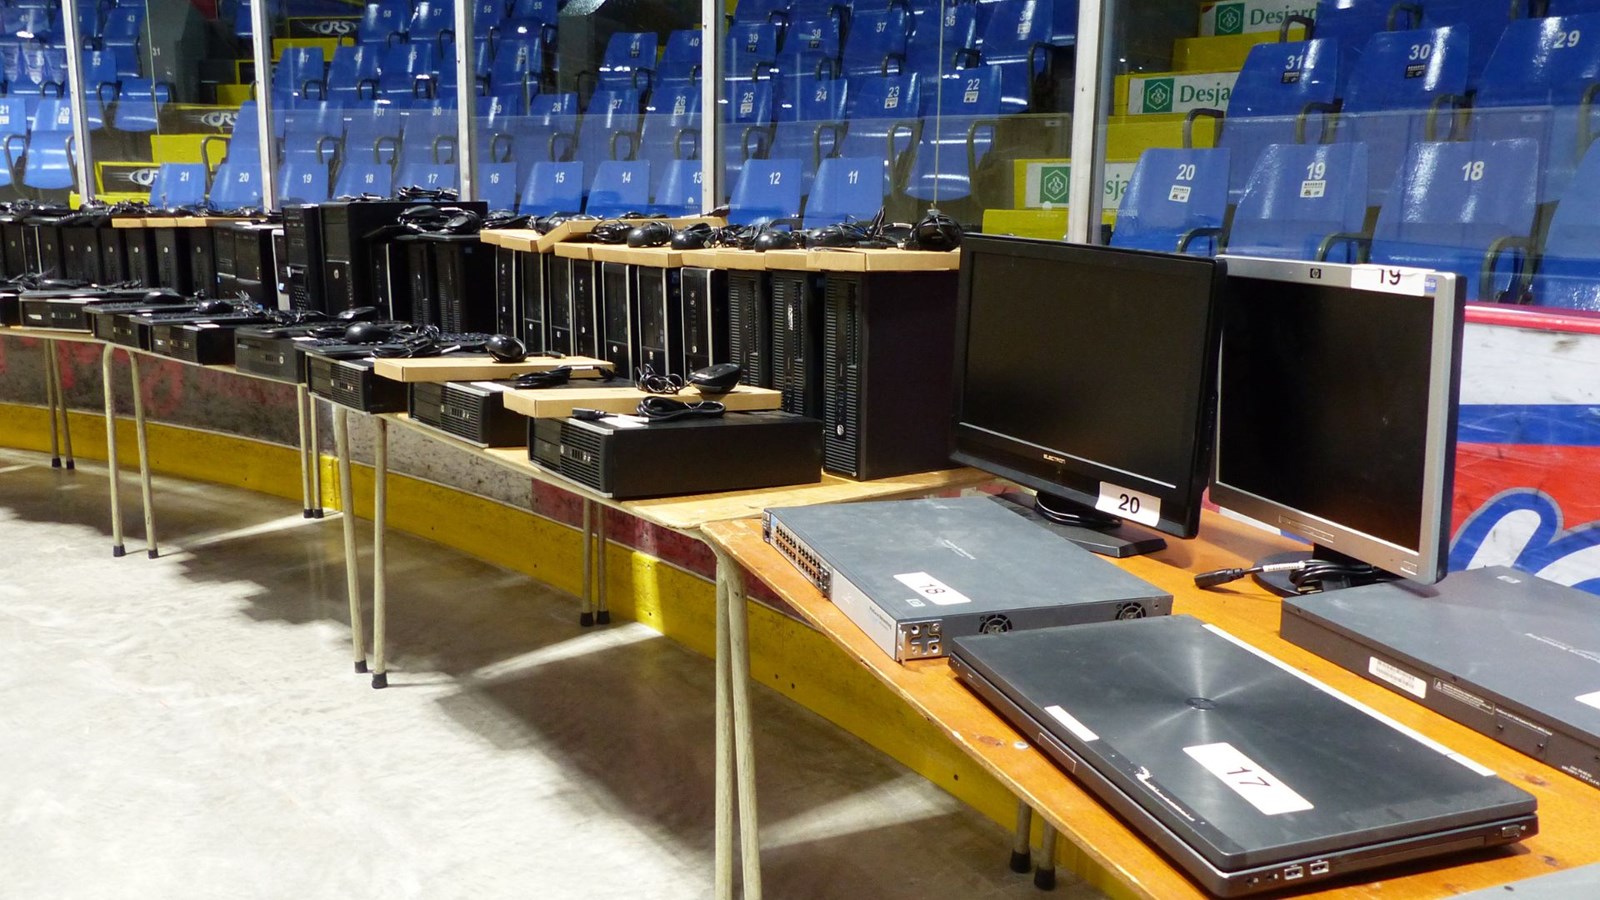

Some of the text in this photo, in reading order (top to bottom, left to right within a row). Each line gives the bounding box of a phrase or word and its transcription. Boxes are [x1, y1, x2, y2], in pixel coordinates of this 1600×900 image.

[876, 22, 887, 33] 37
[631, 41, 640, 50] 41
[689, 38, 700, 47] 40
[1553, 30, 1580, 49] 29
[1408, 44, 1431, 60] 30
[1286, 54, 1303, 70] 31
[966, 78, 980, 91] 22
[742, 92, 754, 103] 25
[815, 90, 827, 102] 24
[887, 87, 900, 97] 23
[612, 99, 623, 109] 27
[675, 95, 686, 106] 26
[60, 106, 70, 116] 20
[180, 171, 189, 182] 21
[1176, 163, 1196, 181] 20
[1306, 161, 1326, 180] 19
[1461, 160, 1485, 182] 18
[239, 172, 250, 183] 20
[302, 173, 312, 184] 19
[365, 173, 374, 184] 18
[427, 173, 439, 184] 17
[490, 172, 499, 184] 16
[555, 171, 565, 183] 15
[621, 171, 632, 183] 14
[769, 171, 782, 185] 12
[848, 171, 859, 185] 11
[1118, 493, 1140, 514] 20
[919, 583, 946, 595] 18
[1226, 766, 1271, 787] 17
